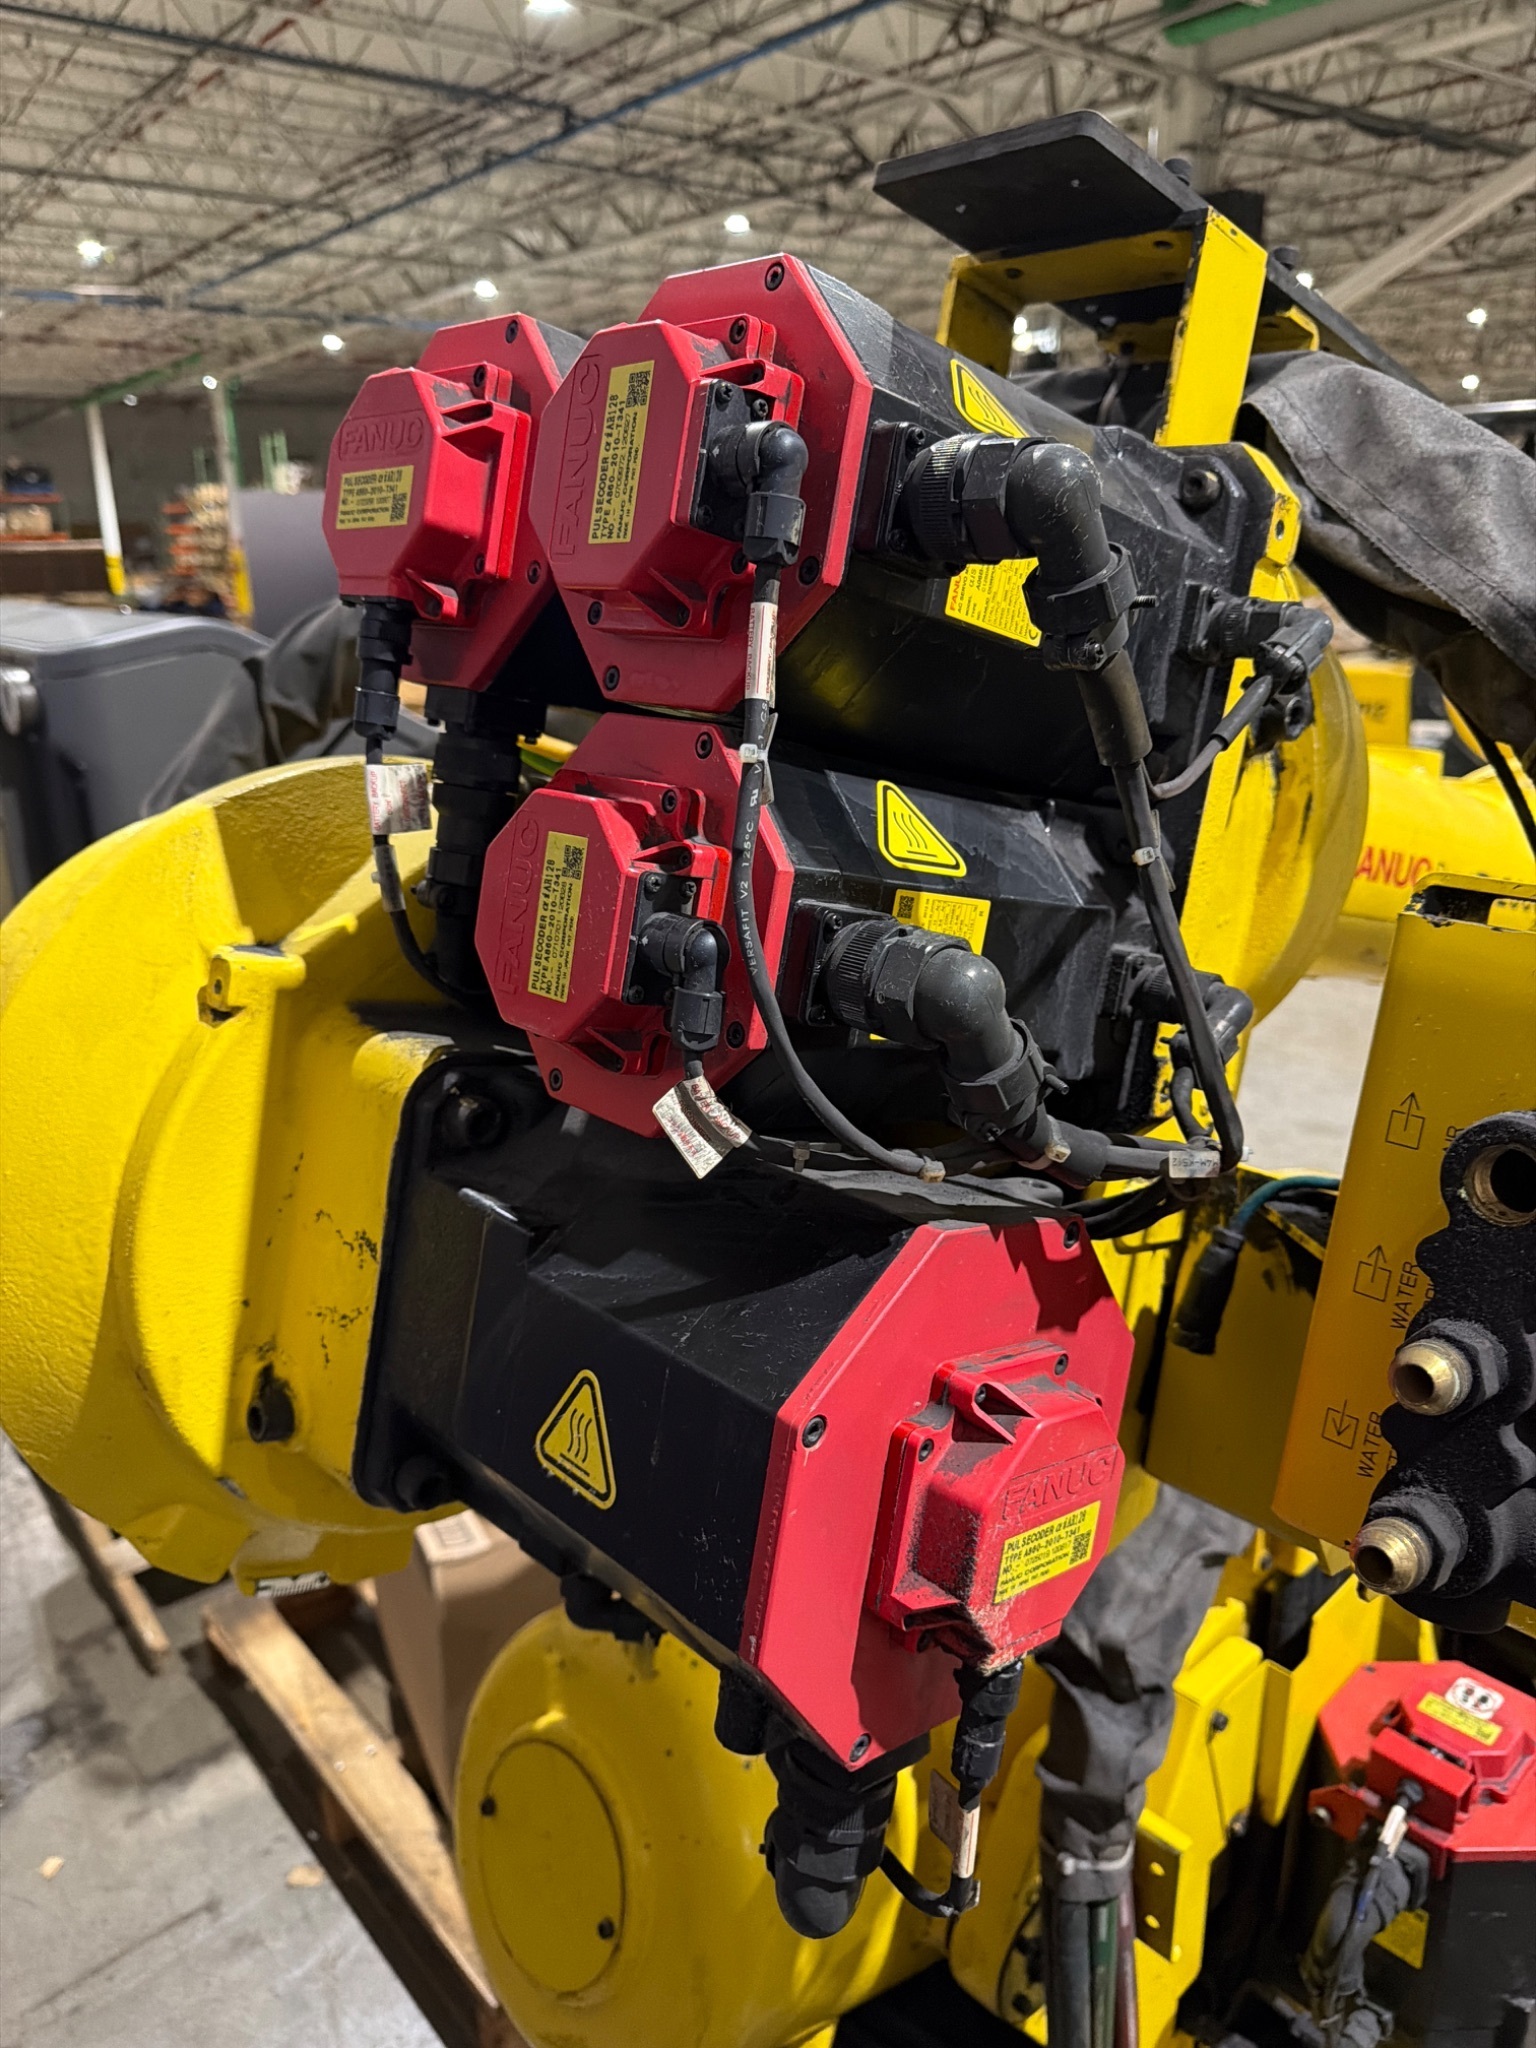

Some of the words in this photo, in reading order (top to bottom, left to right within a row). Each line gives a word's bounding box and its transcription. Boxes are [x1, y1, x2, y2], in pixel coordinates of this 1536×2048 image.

[343, 417, 424, 455] FANUC
[554, 363, 600, 555] FANUC
[600, 509, 610, 537] TYPE
[606, 401, 624, 504] A860-2010-T341
[591, 457, 608, 538] PULSECODER
[616, 500, 625, 538] FANUC
[622, 412, 637, 494] CORPORATION
[740, 880, 749, 900] V2
[1355, 846, 1432, 888] ANUC
[498, 818, 540, 996] FANUC
[539, 965, 548, 990] TYPE
[544, 868, 560, 961] A860-2010-T341
[554, 962, 562, 996] FANUC
[559, 883, 572, 957] CORPORATION
[531, 915, 546, 989] PULSECODER
[740, 908, 758, 976] VERSAFIT
[1389, 1261, 1418, 1329] WATER
[1356, 1411, 1382, 1478] WATER
[1002, 1457, 1109, 1522] FANUC
[1005, 1550, 1021, 1564] TYPE
[1006, 1525, 1053, 1552] PULSECODER
